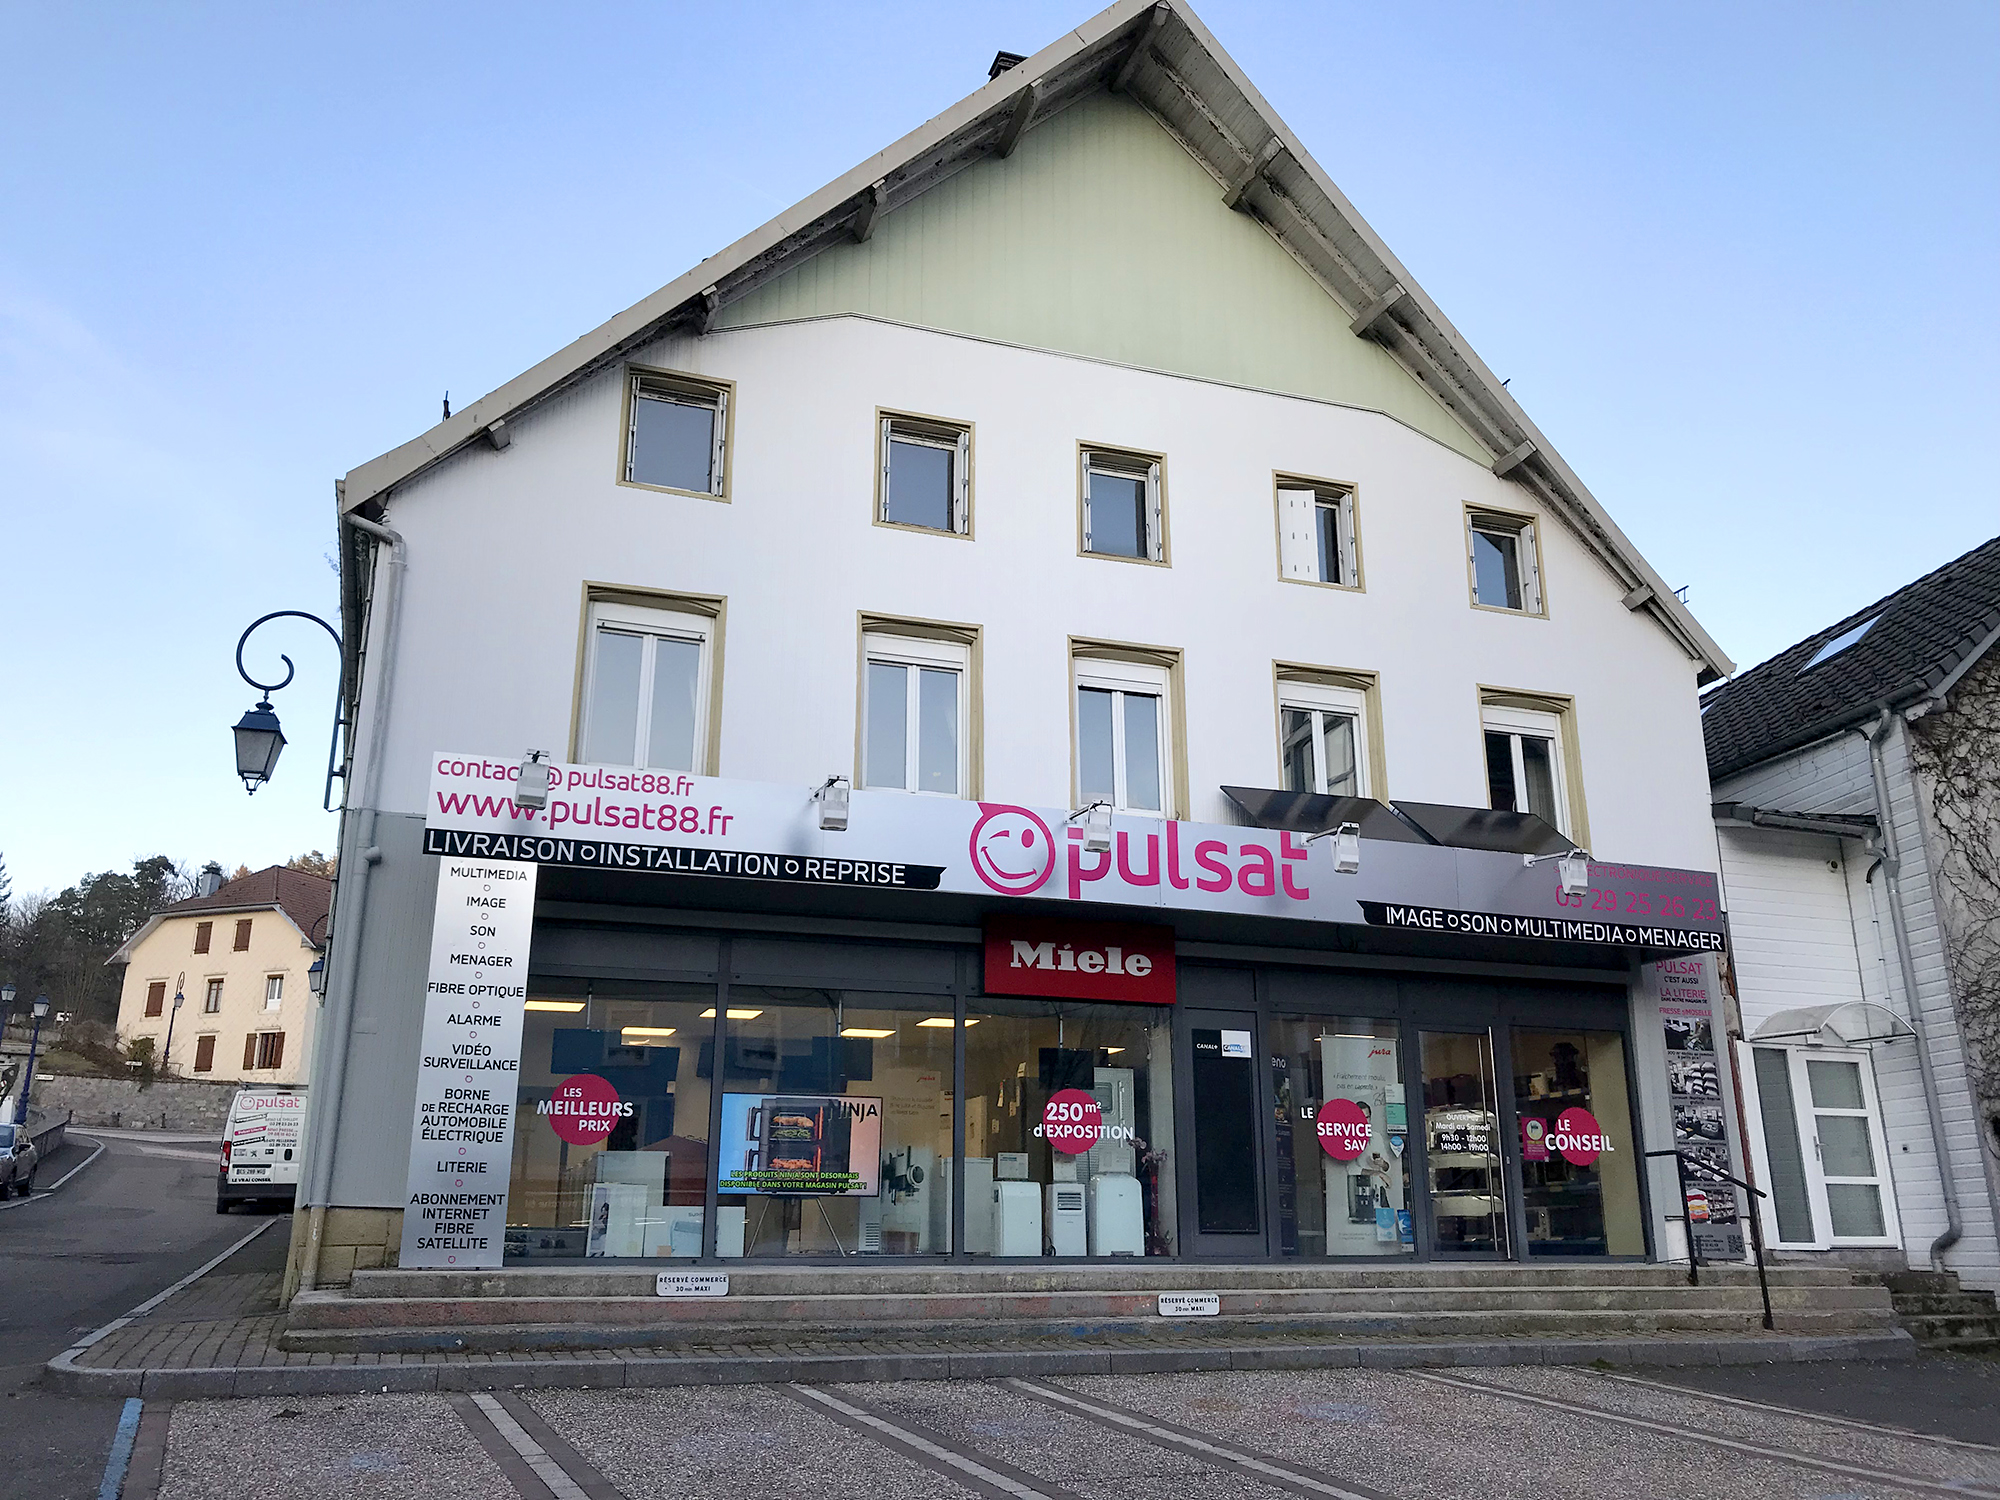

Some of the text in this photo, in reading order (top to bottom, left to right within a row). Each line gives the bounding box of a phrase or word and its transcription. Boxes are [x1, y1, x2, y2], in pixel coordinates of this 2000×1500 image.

[428, 830, 906, 885] LIVRAISON INSTALLATION REPRISE
[1068, 820, 1310, 900] pulsat
[450, 866, 528, 881] MULTIMEDIA
[1664, 873, 1713, 888] SERVICE
[466, 896, 507, 909] IMAGE
[1590, 888, 1618, 912] 29
[1624, 891, 1651, 915] 25
[1658, 894, 1685, 918] 26
[1691, 897, 1718, 921] 23
[469, 925, 496, 937] SON
[1386, 906, 1723, 951] IMAGE SON MULTIMEDIA MENAGER
[449, 953, 513, 967] MENAGER
[1010, 939, 1153, 977] Miele
[1655, 960, 1703, 976] PULSAT
[1681, 976, 1699, 985] AUSSI
[427, 982, 524, 999] FIBRE OPTIQUE
[1659, 987, 1706, 999] LA LITERIE
[446, 1013, 502, 1027] ALARME
[452, 1042, 492, 1056] VIDÉO
[1367, 1045, 1391, 1059] jura
[423, 1056, 518, 1071] SURVEILLANCE
[444, 1088, 491, 1101] BORNE
[563, 1087, 582, 1098] LES
[256, 1096, 300, 1111] pulsat
[421, 1102, 510, 1115] DE RECHARGE
[536, 1099, 634, 1118] MEILLEURS
[1046, 1101, 1084, 1122] 250
[1300, 1106, 1314, 1119] LE
[420, 1115, 508, 1129] AUTOMOBILE
[578, 1119, 611, 1132] PRIX
[1557, 1118, 1571, 1132] LE
[421, 1126, 504, 1144] ÉLECTRIQUE
[1033, 1123, 1134, 1140] d'EXPOSITION
[1316, 1122, 1373, 1137] SERVICE
[1441, 1133, 1460, 1142] 9h30
[1544, 1133, 1615, 1152] CONSEIL
[1344, 1138, 1367, 1152] SAV
[437, 1161, 488, 1174] LITERIE
[744, 1170, 778, 1179] PRODUITS
[801, 1171, 820, 1179] SONT
[821, 1172, 860, 1180] DESORMAIS
[719, 1180, 760, 1188] DISPONIBLE
[762, 1180, 781, 1188] DANS
[782, 1181, 805, 1189] VOTRE
[805, 1181, 837, 1189] MAGASIN
[410, 1193, 506, 1206] ABONNEMENT
[422, 1208, 490, 1220] INTERNET
[434, 1222, 474, 1235] FIBRE
[417, 1237, 488, 1250] SATELLITE
